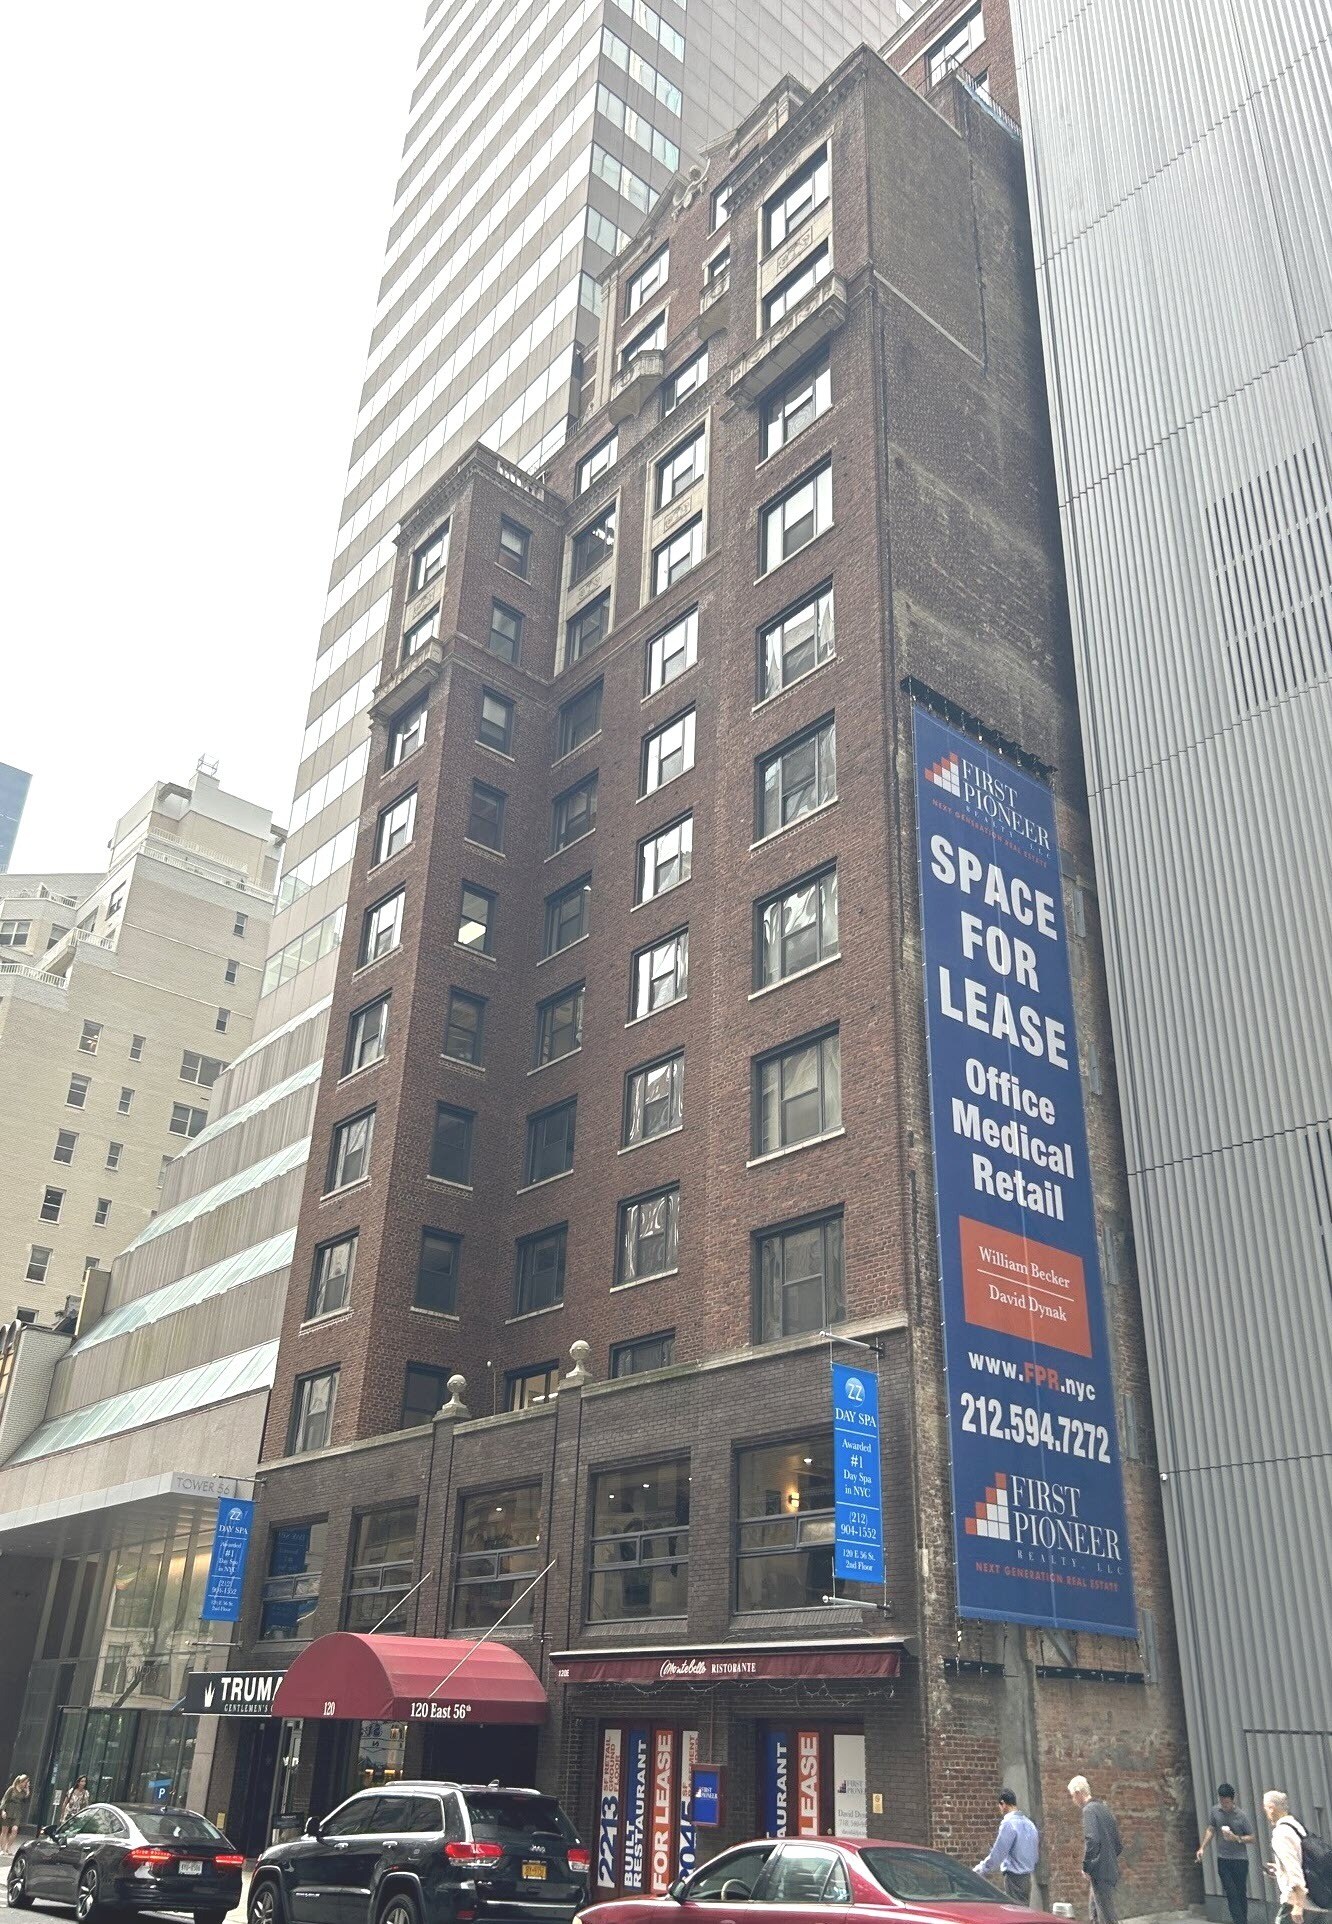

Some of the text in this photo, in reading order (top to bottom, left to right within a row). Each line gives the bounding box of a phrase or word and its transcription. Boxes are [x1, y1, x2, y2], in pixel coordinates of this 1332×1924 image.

[962, 758, 1018, 808] FIRST
[932, 798, 952, 815] NEXT
[954, 812, 1002, 842] GENERATION
[964, 781, 1051, 851] PIONEER
[930, 834, 1058, 941] SPACE
[960, 911, 1040, 993] FOR
[939, 966, 1069, 1070] LEASE
[966, 1057, 1056, 1126] Office
[952, 1097, 1074, 1179] Medical
[972, 1152, 1064, 1222] Retail
[978, 1246, 1070, 1289] William Becker
[989, 1285, 1067, 1322] David Dynak
[968, 1351, 1096, 1402] www.FPR.nyc
[835, 1407, 877, 1428] DAY SPA
[960, 1392, 1111, 1464] 212.594.7272
[842, 1438, 872, 1453] Awarded
[850, 1454, 863, 1469] #1
[177, 1477, 230, 1495] TOWER 56
[843, 1469, 872, 1486] Day Spa
[845, 1484, 871, 1498] in NYC
[1010, 1475, 1081, 1518] FIRST
[219, 1524, 248, 1535] DAY SPA
[840, 1523, 877, 1540] 904-1552
[849, 1511, 868, 1526] (212)
[1013, 1511, 1122, 1560] PIONEER
[225, 1549, 234, 1558] #1
[845, 1560, 874, 1572] 2nd Floor
[1097, 1562, 1124, 1575] LLC
[975, 1561, 1121, 1593] NEXT GENERATION REAL ESTATE
[660, 1659, 757, 1678] Montebello RISTORANTE
[224, 1703, 268, 1713] GENTLEMEN'S
[323, 1701, 335, 1716] 120
[410, 1702, 472, 1719] 120 East 56th
[158, 1788, 166, 1798] P
[801, 1737, 818, 1836] LEASE
[632, 1740, 647, 1888] RESTAURANT
[653, 1734, 673, 1891] FOR LEASE
[598, 1796, 619, 1888] 2213
[624, 1820, 635, 1887] BUILT
